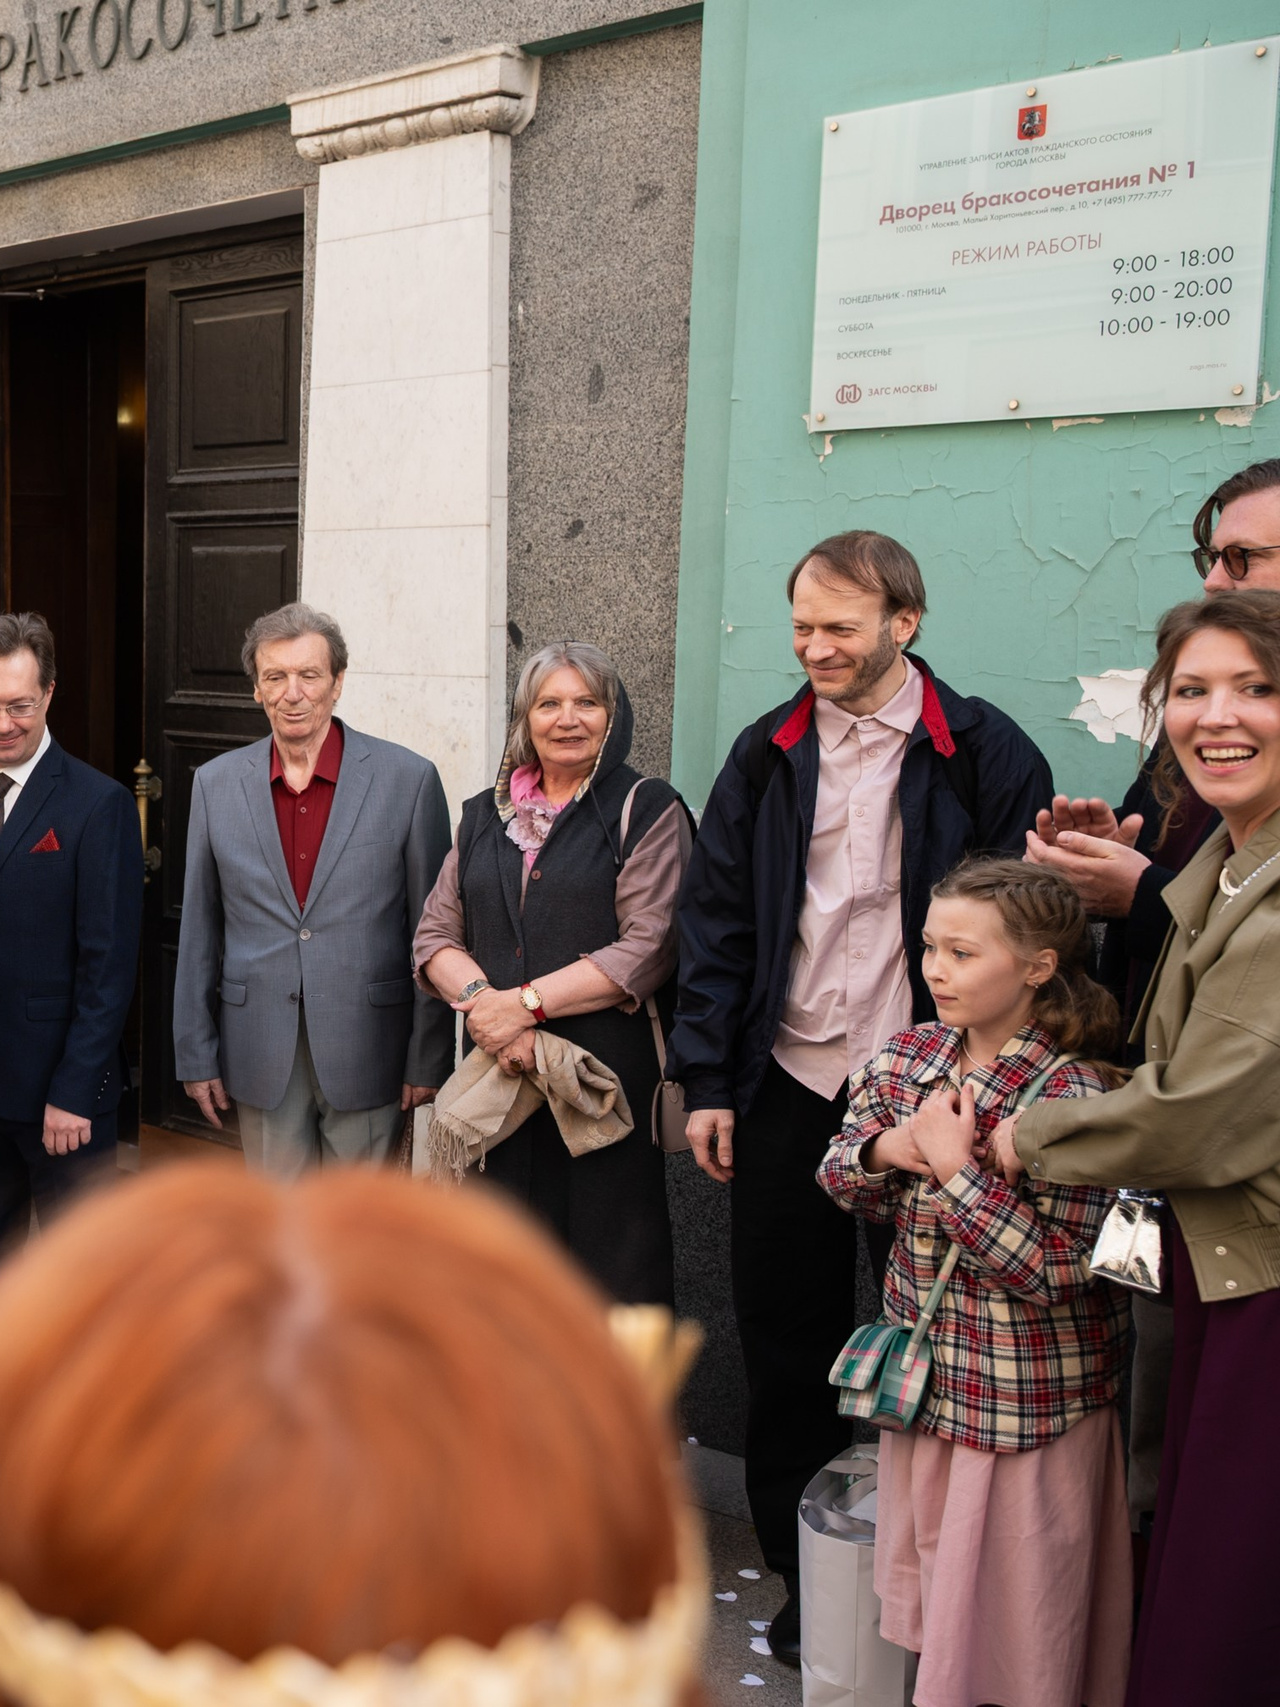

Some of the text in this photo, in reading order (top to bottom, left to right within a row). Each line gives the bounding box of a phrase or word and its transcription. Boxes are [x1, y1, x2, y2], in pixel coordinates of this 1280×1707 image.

[919, 128, 1153, 171] УПРАВЛЕНИЕ ЗАПИСИ АКТОВ ГРАЖДАНСКОГО СОСТОЯНИЯ
[995, 153, 1066, 170] ГОРОДА МОСКВЫ
[878, 160, 1195, 226] Дворец бракосочетания № 1
[895, 223, 923, 234] 101000,
[931, 219, 960, 229] Москва,
[962, 215, 988, 224] Малый
[989, 207, 1049, 221] Харитоньевский
[1092, 198, 1102, 206] +7
[1104, 195, 1126, 207] (495)
[1127, 189, 1173, 203] 777-77-77
[951, 232, 1102, 266] РЕЖИМ РАБОТЫ
[1112, 254, 1157, 275] 9:00
[1180, 245, 1234, 267] 18:00
[838, 291, 900, 305] ПОНЕДЕЛЬНИК
[906, 286, 947, 298] ПЯТНИЦА
[1111, 284, 1155, 305] 9:00
[1174, 276, 1233, 299] 20:00
[837, 322, 874, 333] СУББОТА
[1099, 315, 1153, 336] 10:00
[1175, 308, 1231, 329] 19:00
[836, 347, 893, 360] ВОСКРЕСЕНЬЕ
[868, 383, 938, 397] ЗАГС МОСКВЫ
